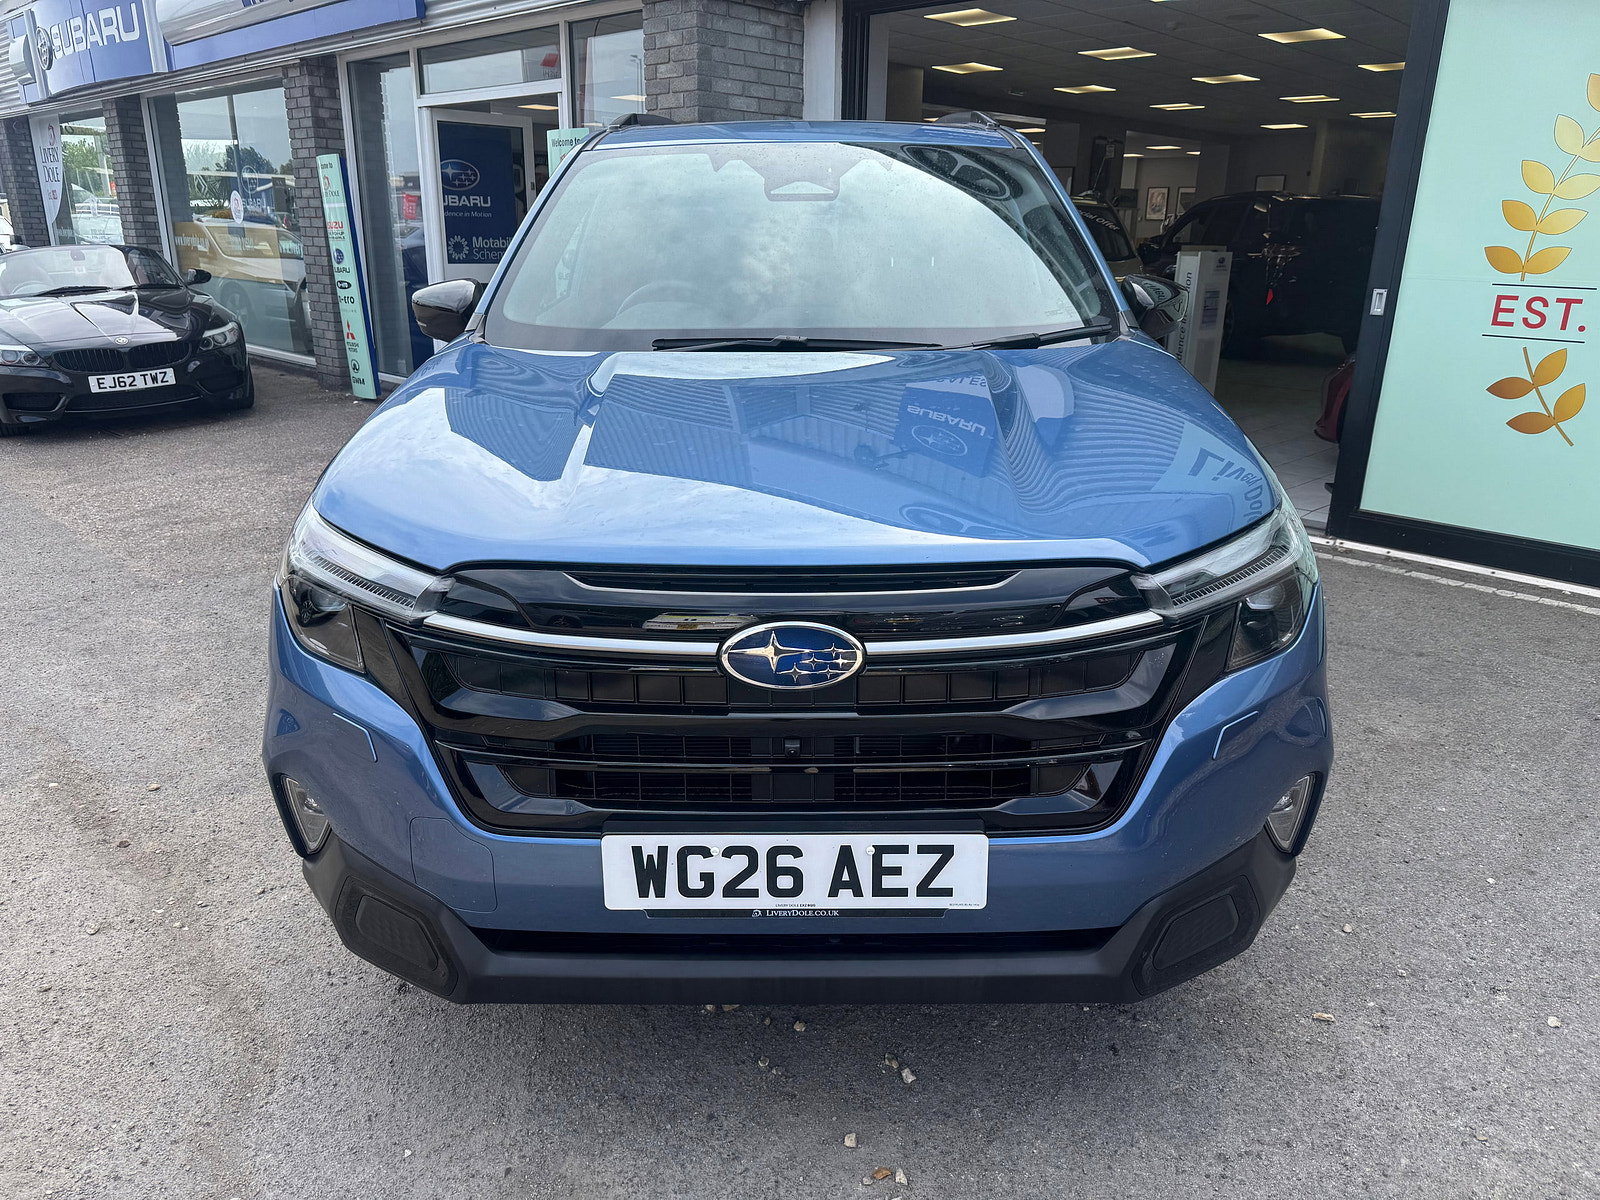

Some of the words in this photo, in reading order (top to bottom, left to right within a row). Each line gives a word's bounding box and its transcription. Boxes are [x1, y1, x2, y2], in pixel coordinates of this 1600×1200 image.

[50, 2, 140, 60] SUBARU
[43, 166, 60, 183] DOLE
[443, 195, 491, 207] BARU
[1079, 209, 1097, 221] cial
[1096, 217, 1121, 231] Offer
[472, 236, 514, 248] Motabi
[1491, 294, 1586, 332] EST.
[96, 375, 137, 390] EJ62
[140, 371, 169, 386] TWZ
[631, 845, 804, 899] WG26
[827, 844, 955, 898] AEZ
